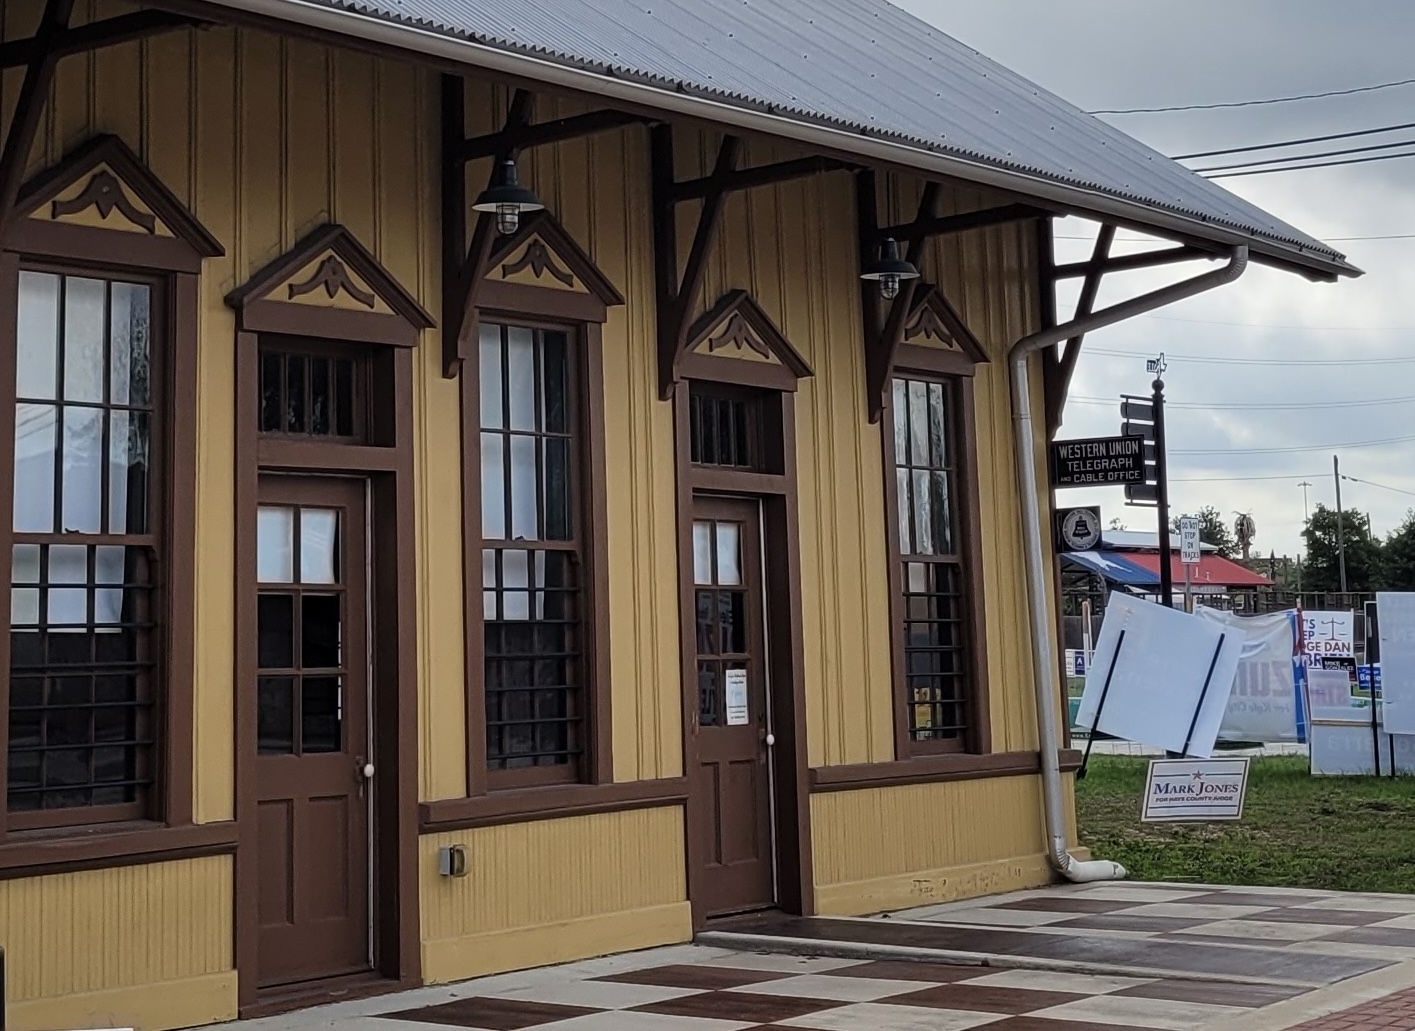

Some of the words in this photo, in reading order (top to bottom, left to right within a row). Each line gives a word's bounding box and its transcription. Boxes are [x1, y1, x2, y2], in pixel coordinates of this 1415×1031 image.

[1058, 443, 1106, 459] WESTERN
[1109, 440, 1139, 455] UNION
[1067, 457, 1133, 472] TELEGRAPH
[1073, 472, 1105, 483] CABLE
[1107, 470, 1141, 481] OFFICE
[1182, 552, 1199, 560] TRACKS
[1325, 642, 1351, 653] DAN
[1153, 783, 1195, 795] MARK
[1195, 782, 1239, 796] JONES
